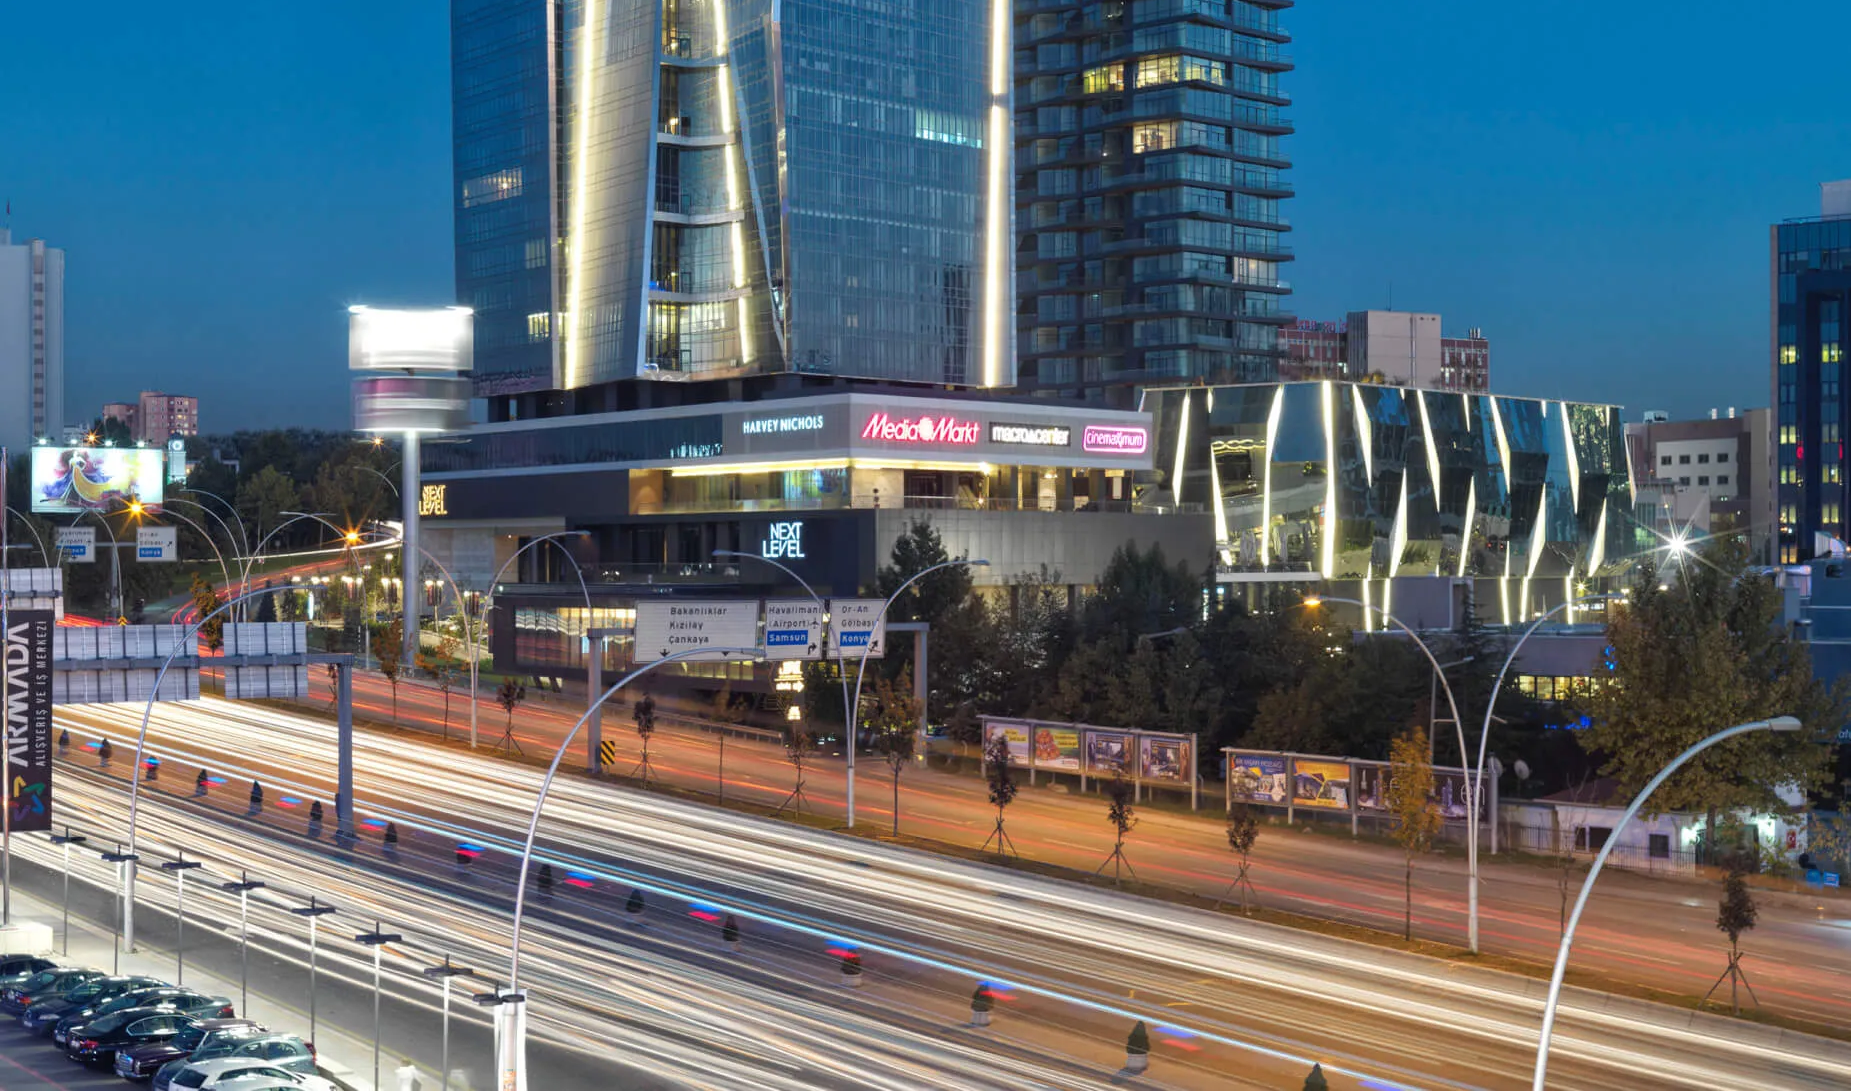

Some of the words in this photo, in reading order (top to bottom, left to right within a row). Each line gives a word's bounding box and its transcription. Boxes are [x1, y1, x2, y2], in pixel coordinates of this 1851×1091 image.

[743, 418, 779, 434] HARVEY
[780, 414, 824, 432] NICHOLS
[422, 484, 447, 501] NEXT
[418, 500, 448, 516] LEVEL
[770, 521, 803, 540] NEXT
[762, 540, 805, 558] LEVEL
[768, 633, 807, 642] Samsun
[7, 621, 30, 768] ARMADA
[35, 690, 46, 704] VE
